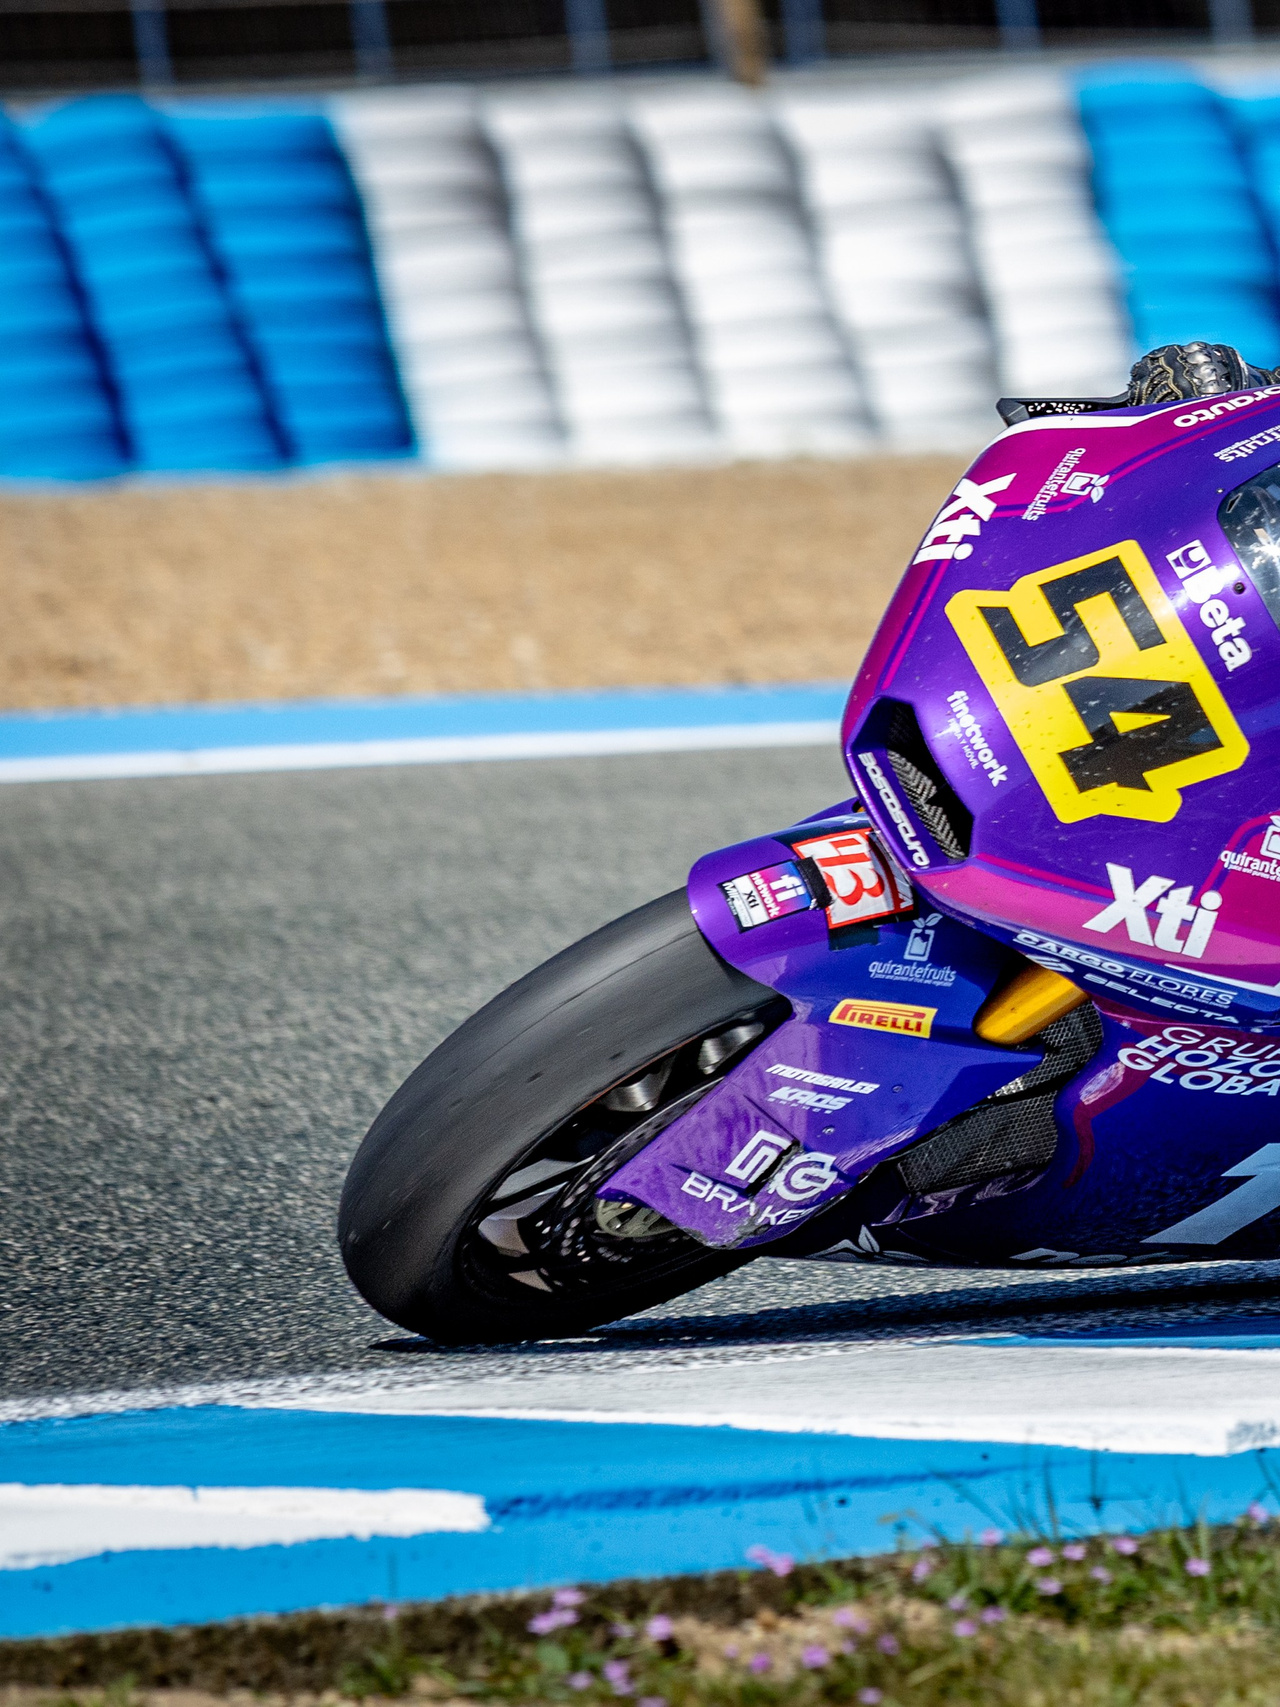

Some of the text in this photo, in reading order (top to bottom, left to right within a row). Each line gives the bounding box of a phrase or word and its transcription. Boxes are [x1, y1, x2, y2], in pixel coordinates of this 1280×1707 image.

[912, 473, 1017, 565] Xti
[976, 555, 1225, 794] 54
[946, 690, 1009, 788] finetwork
[750, 871, 780, 918] network
[770, 873, 806, 903] fi
[1082, 862, 1223, 959] Xti
[868, 961, 956, 984] quirantefruits
[1015, 932, 1126, 974] CARGO
[1129, 969, 1235, 1006] FLORES
[1083, 973, 1240, 1024] SELECTA
[836, 1004, 927, 1033] PIRELLI
